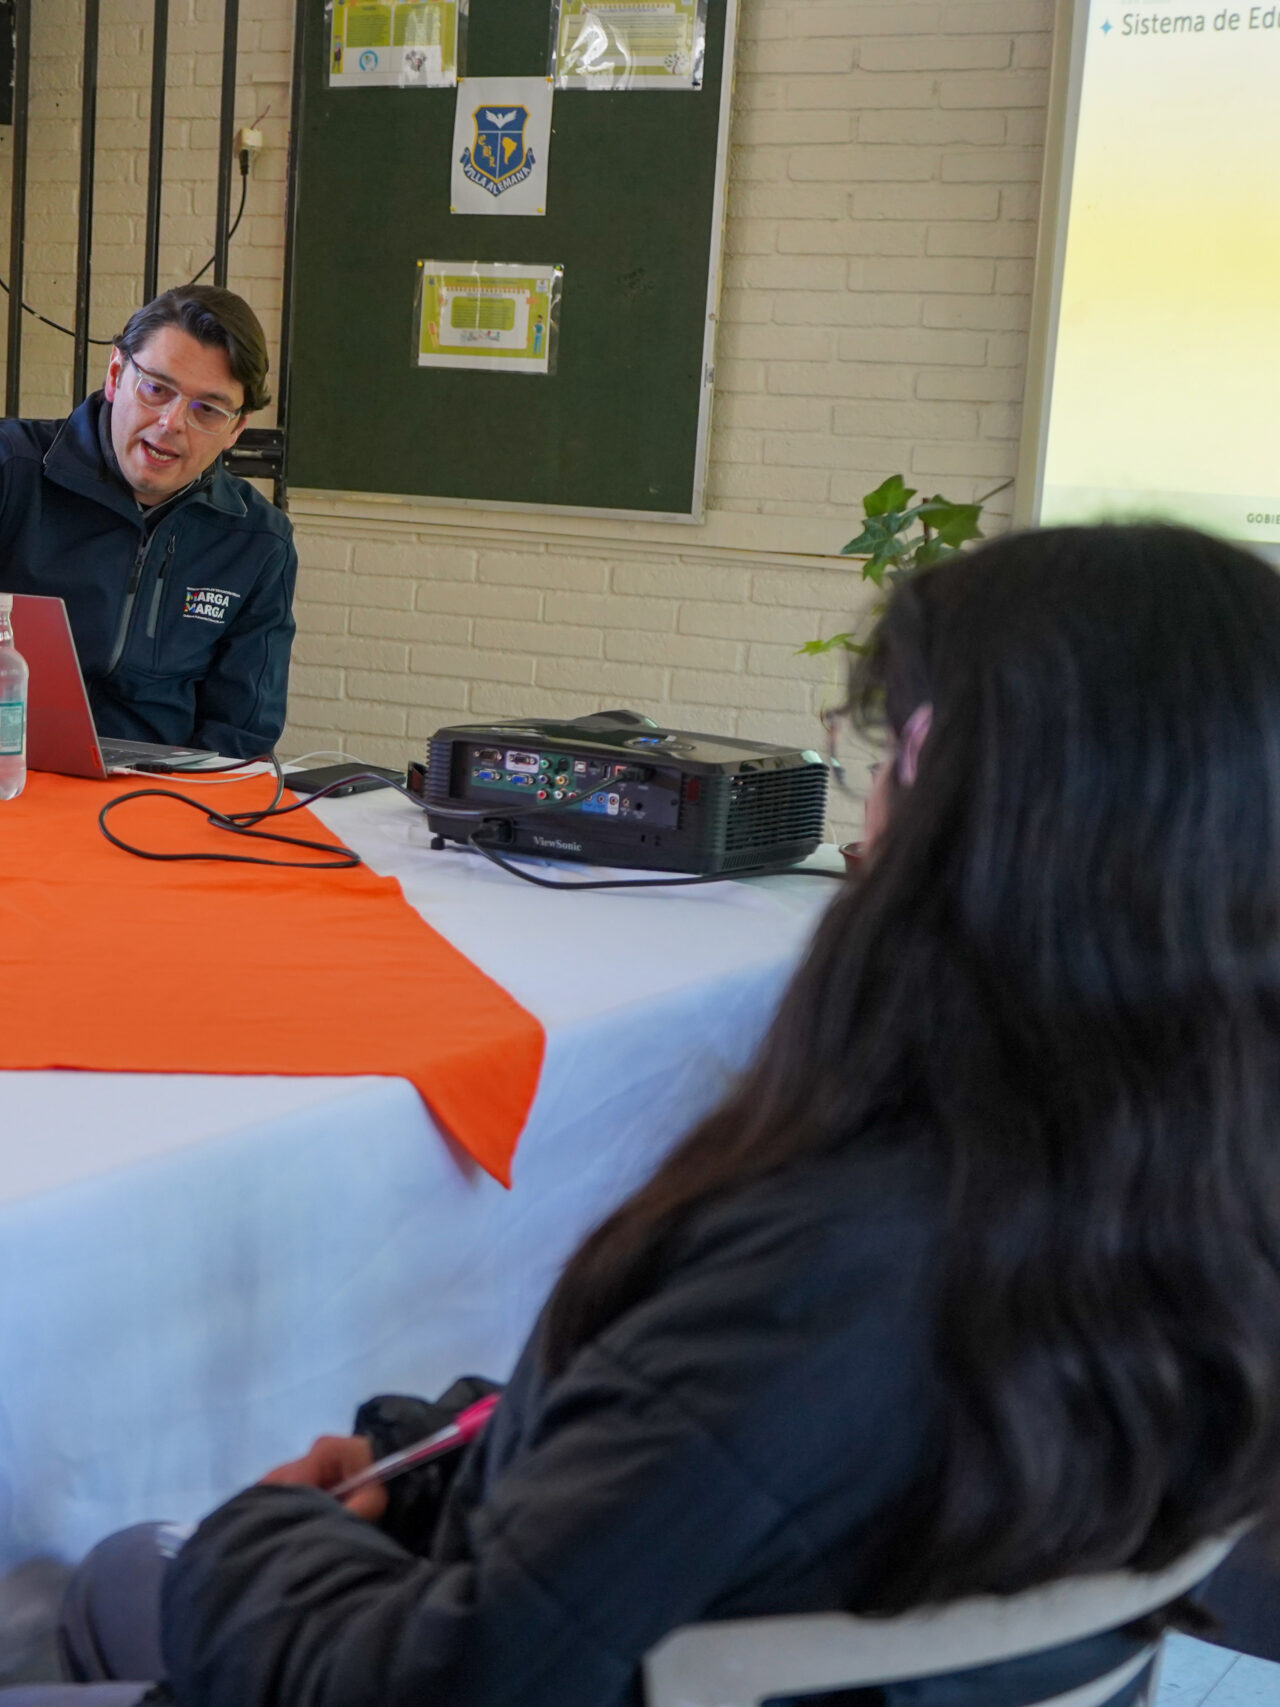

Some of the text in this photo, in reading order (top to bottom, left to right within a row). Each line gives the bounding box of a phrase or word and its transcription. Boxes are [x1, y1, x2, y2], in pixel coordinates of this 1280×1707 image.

[1121, 13, 1205, 36] Sistema
[1213, 9, 1241, 32] de
[464, 163, 531, 194] VILLA ALEMANA
[185, 591, 230, 607] MARGA
[183, 602, 225, 619] MARGA
[533, 836, 582, 851] ViewSonic
